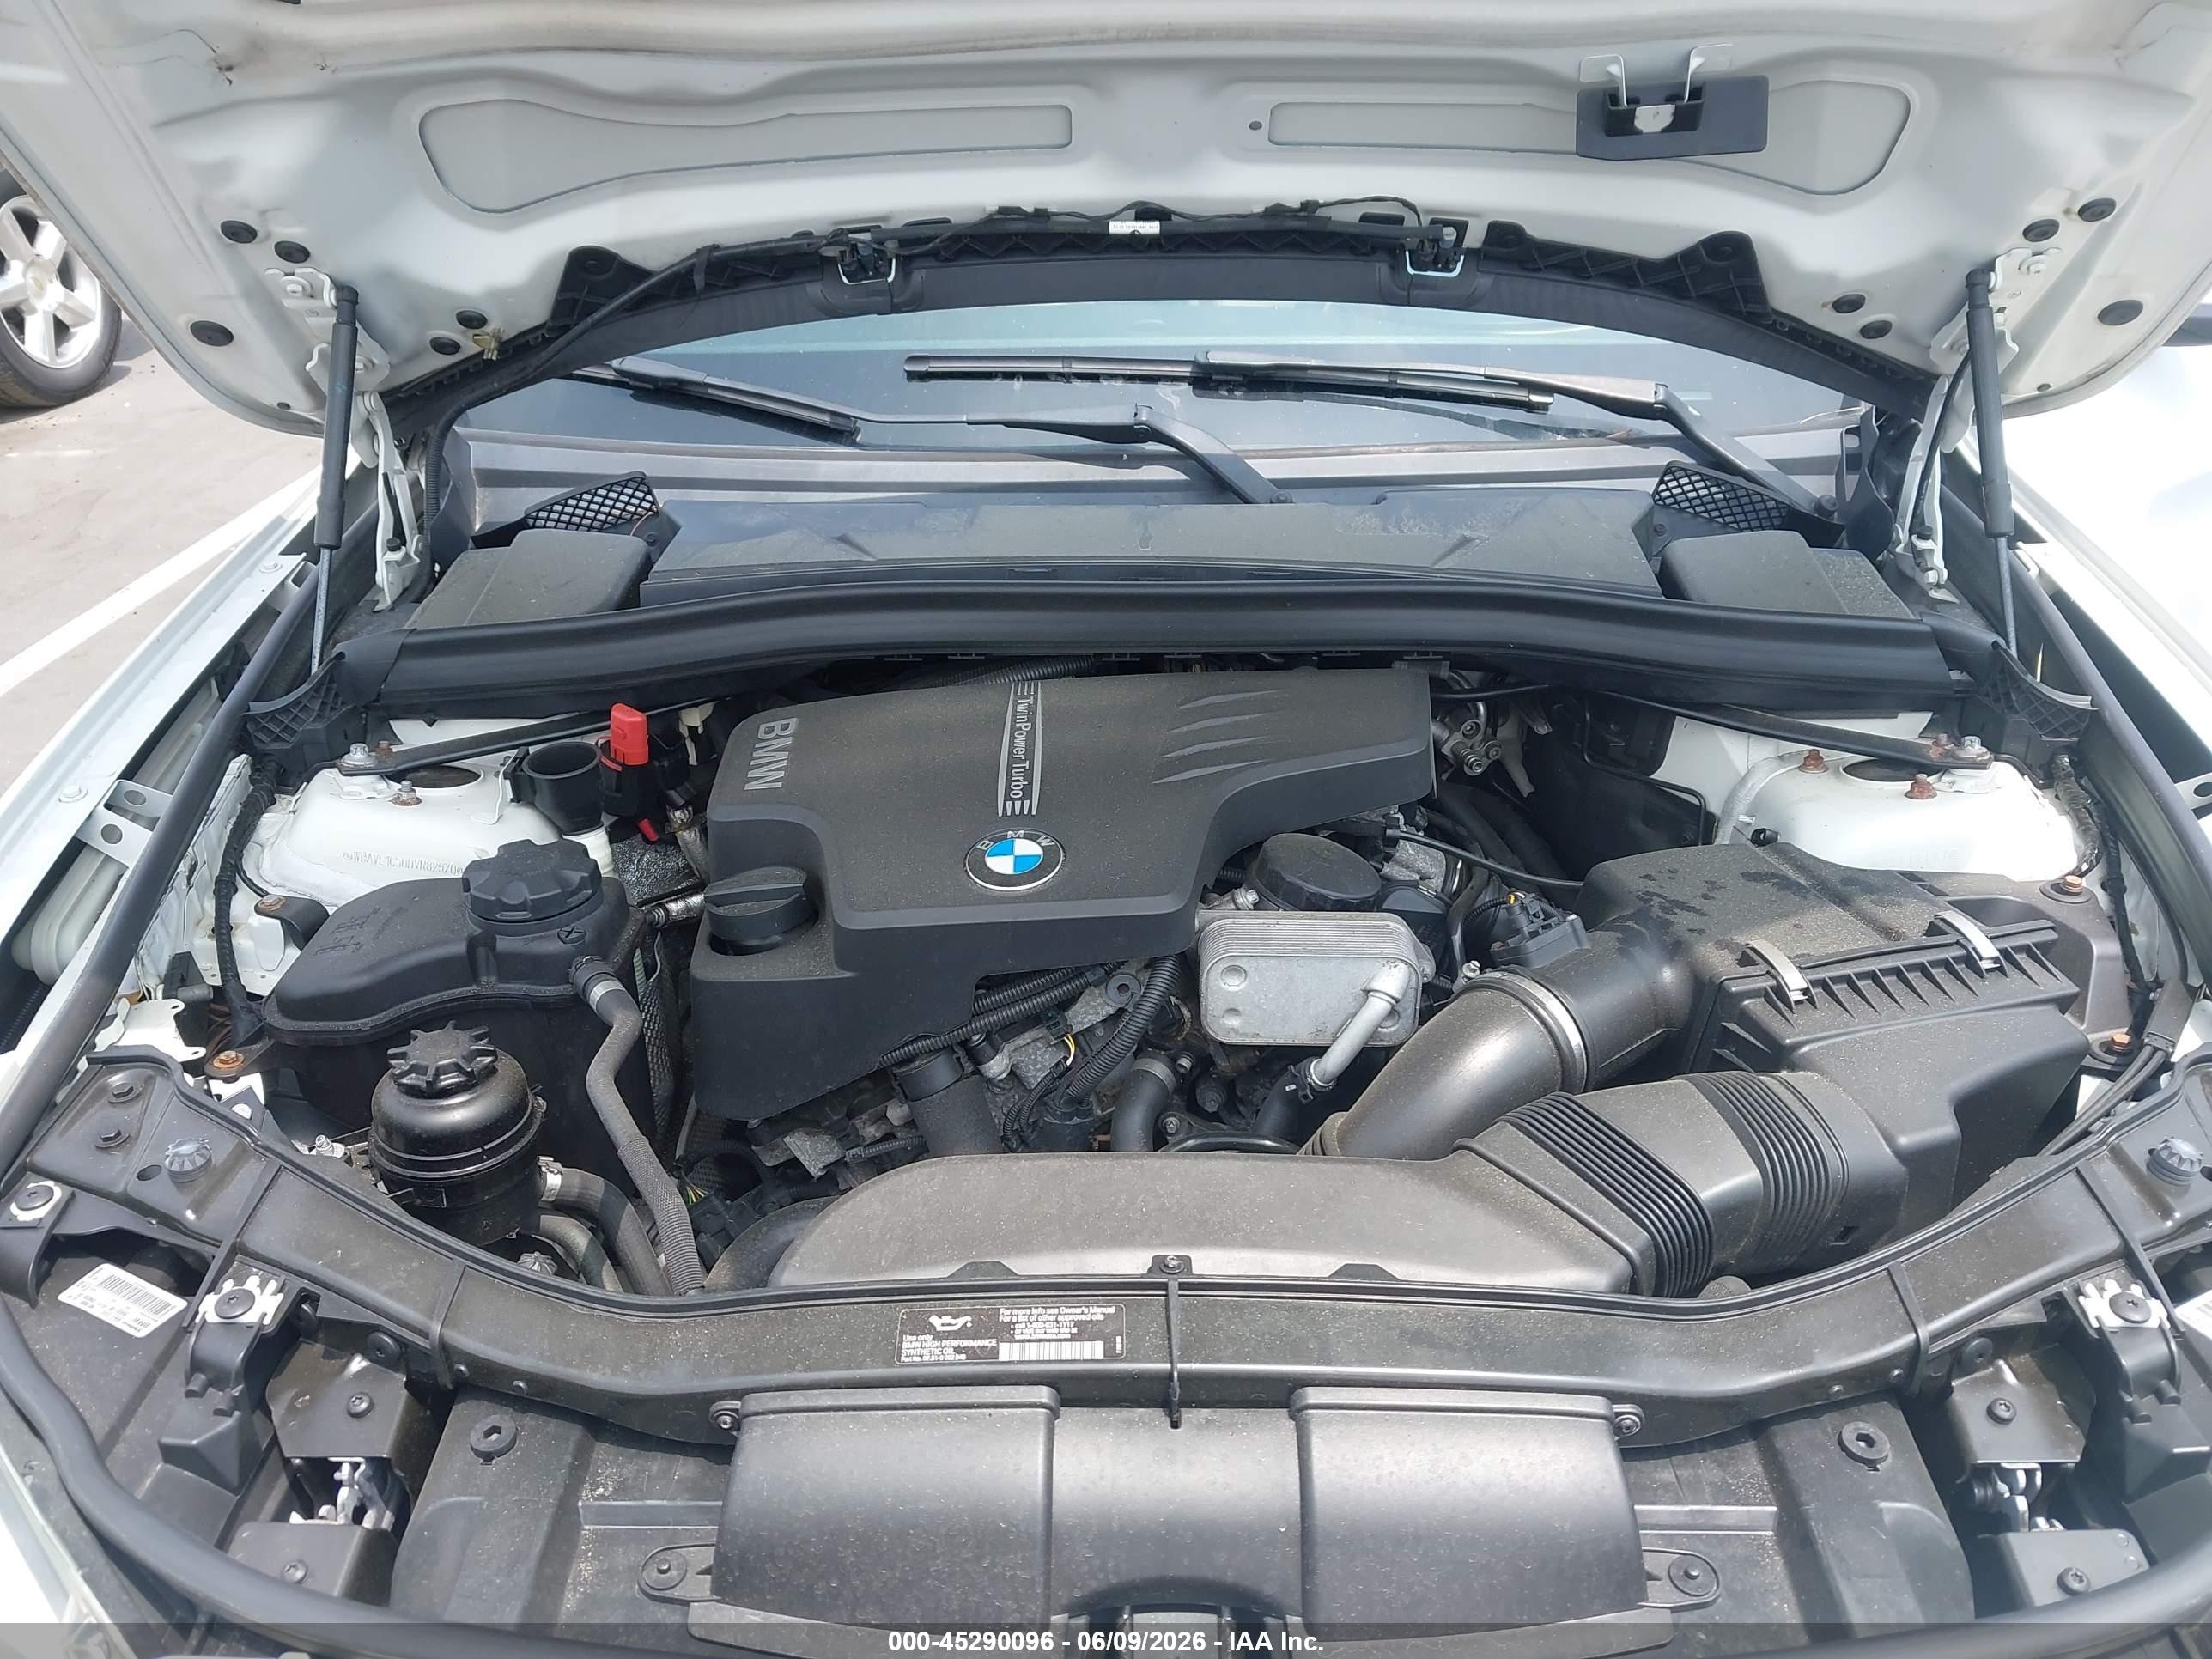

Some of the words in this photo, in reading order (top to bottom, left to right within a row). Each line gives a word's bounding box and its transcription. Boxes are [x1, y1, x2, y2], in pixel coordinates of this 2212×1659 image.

[1012, 697, 1034, 759] TwinPower
[744, 717, 798, 791] BMW
[1010, 760, 1030, 799] Turbo
[902, 1340, 921, 1349] BMW
[941, 1339, 998, 1347] PERFORMANCE
[902, 1347, 942, 1356] SYNTHETIC
[943, 1346, 956, 1355] OIL
